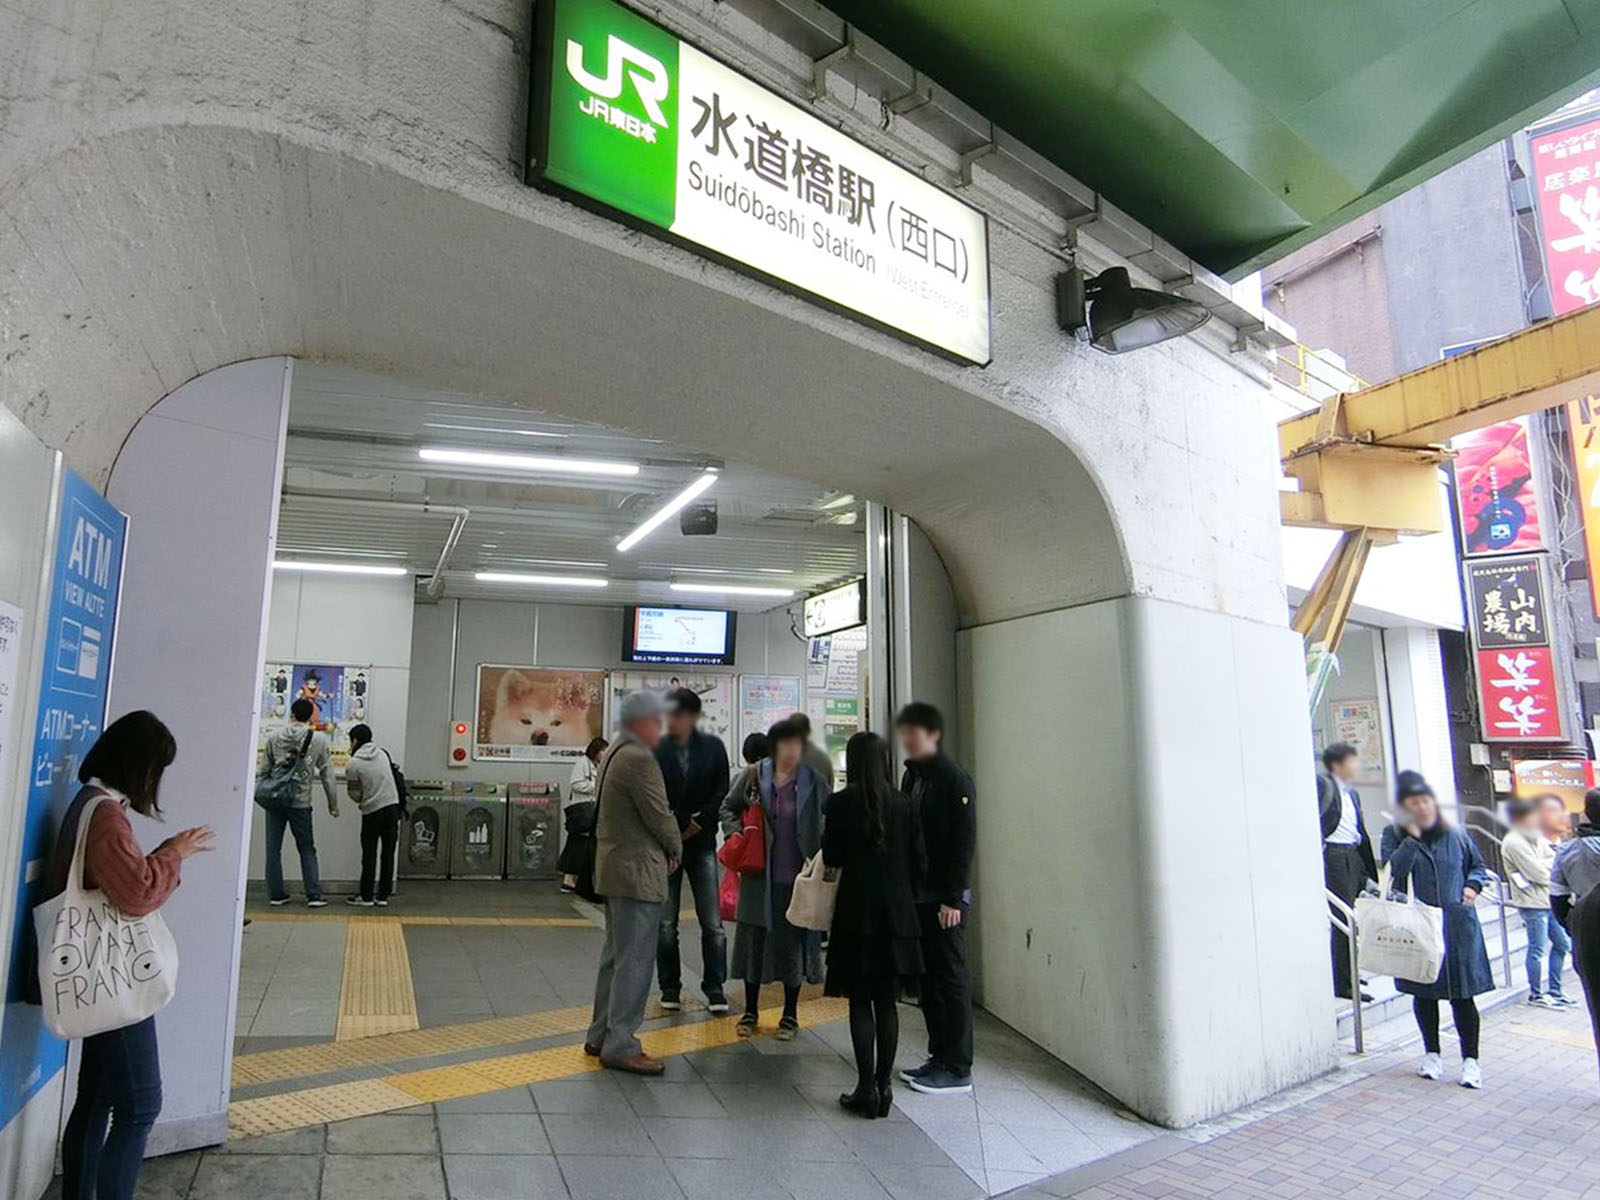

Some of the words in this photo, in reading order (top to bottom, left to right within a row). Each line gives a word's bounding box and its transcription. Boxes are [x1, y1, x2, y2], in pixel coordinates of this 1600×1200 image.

[579, 98, 657, 145] JR東日本
[813, 224, 876, 274] Station
[68, 517, 111, 590] ATM
[1510, 587, 1536, 633] 山内
[1491, 652, 1546, 736] 笑笑
[41, 709, 97, 742] ATMコーナー
